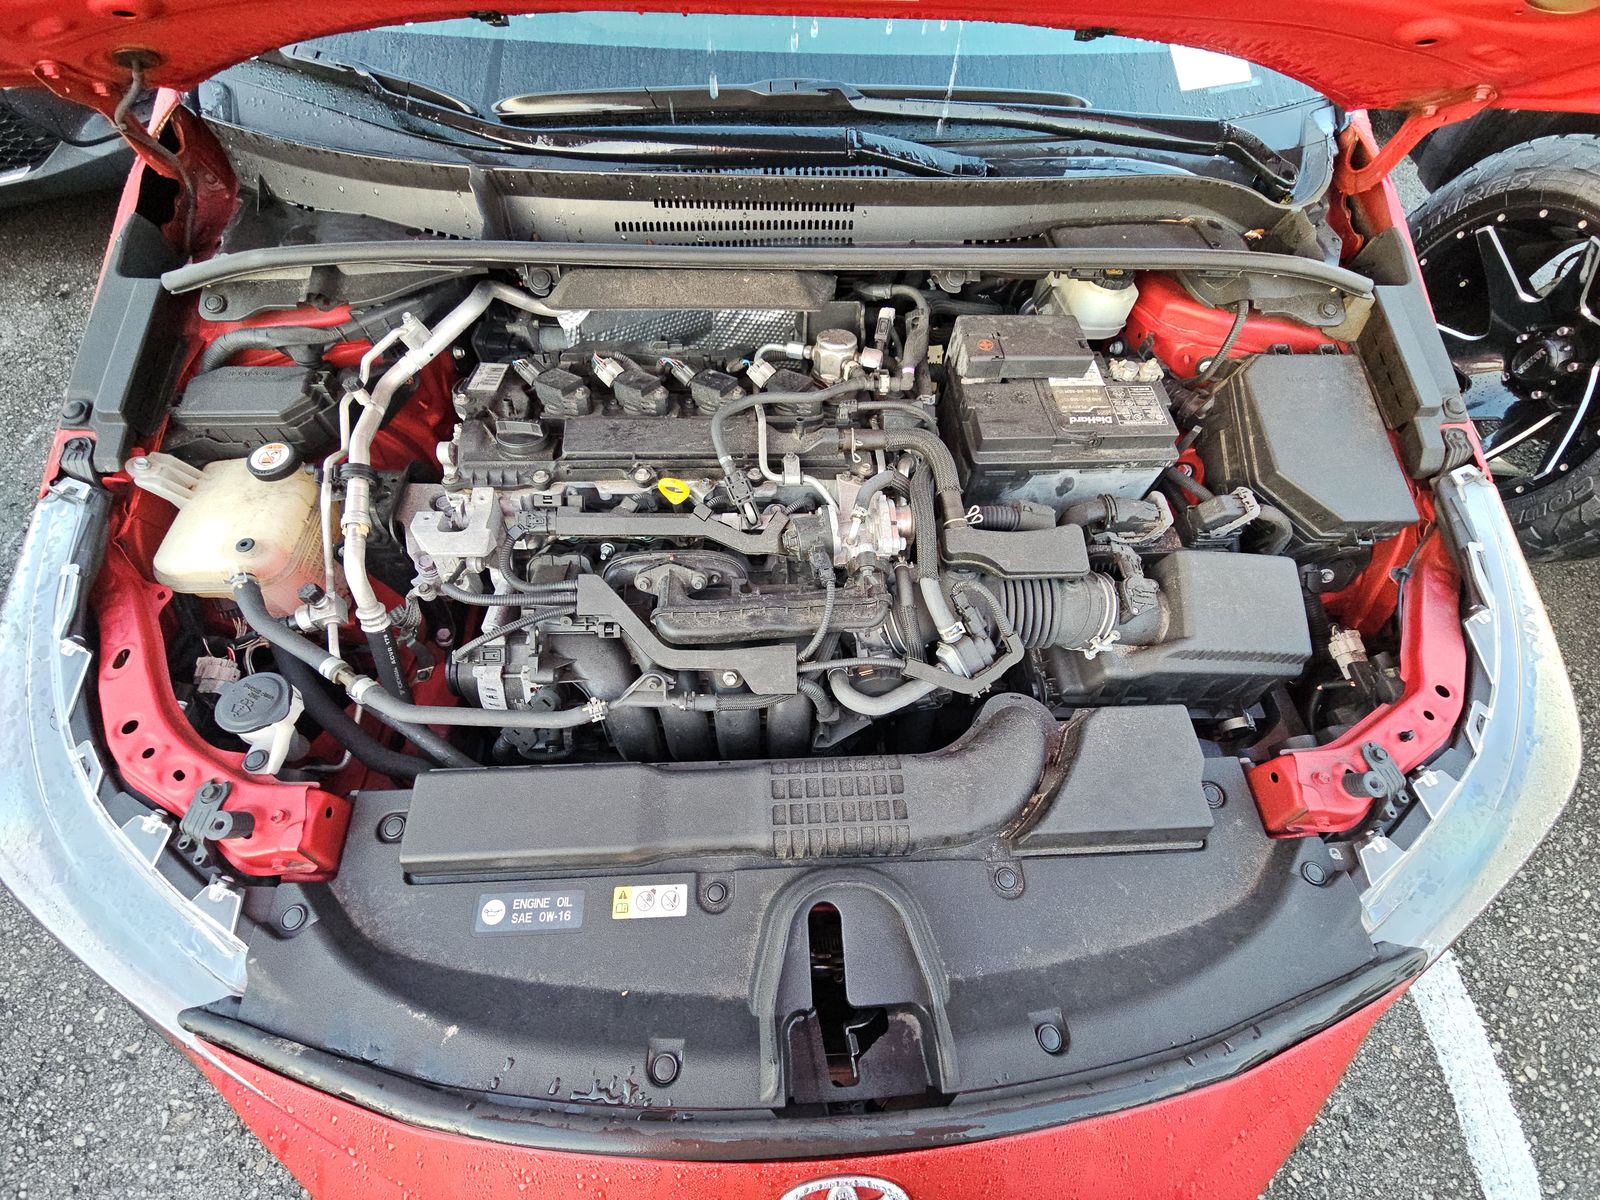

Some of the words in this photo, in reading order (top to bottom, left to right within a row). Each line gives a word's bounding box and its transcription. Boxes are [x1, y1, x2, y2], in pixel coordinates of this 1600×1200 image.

[1428, 172, 1536, 229] TIRES
[1069, 416, 1113, 424] DieHard
[512, 897, 551, 910] ENGINE
[556, 896, 573, 908] OIL
[511, 911, 532, 924] SAE
[539, 910, 571, 923] 0W-16
